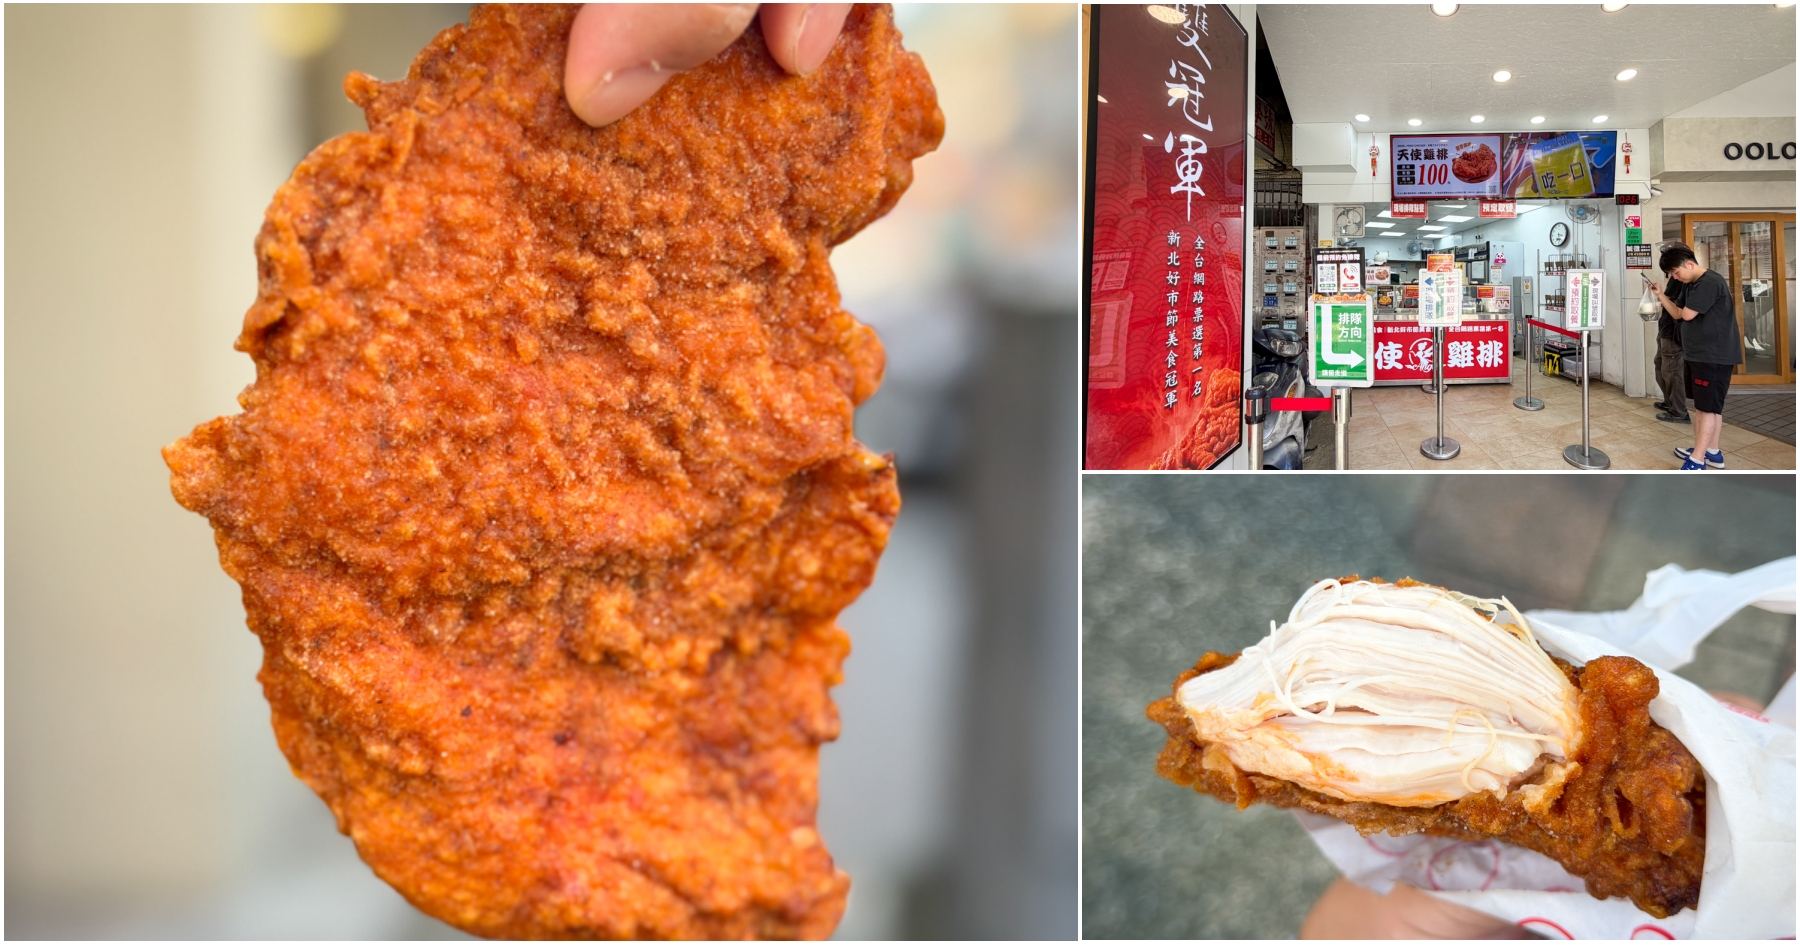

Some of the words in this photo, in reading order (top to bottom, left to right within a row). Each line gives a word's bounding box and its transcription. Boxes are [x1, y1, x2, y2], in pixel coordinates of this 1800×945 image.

[1397, 148, 1448, 161] 天使雞排
[1724, 142, 1796, 160] OOLO
[1541, 162, 1584, 190] 吃一口
[1619, 195, 1637, 204] 026
[1191, 235, 1205, 397] 全台網路票選第一名
[1570, 288, 1580, 325] 預約取餐
[1164, 230, 1180, 409] 新北好市節美食冠軍
[1338, 312, 1362, 325] 排隊
[1338, 326, 1362, 338] 方向
[1374, 341, 1403, 370] 使
[1447, 340, 1503, 368] 雞排
